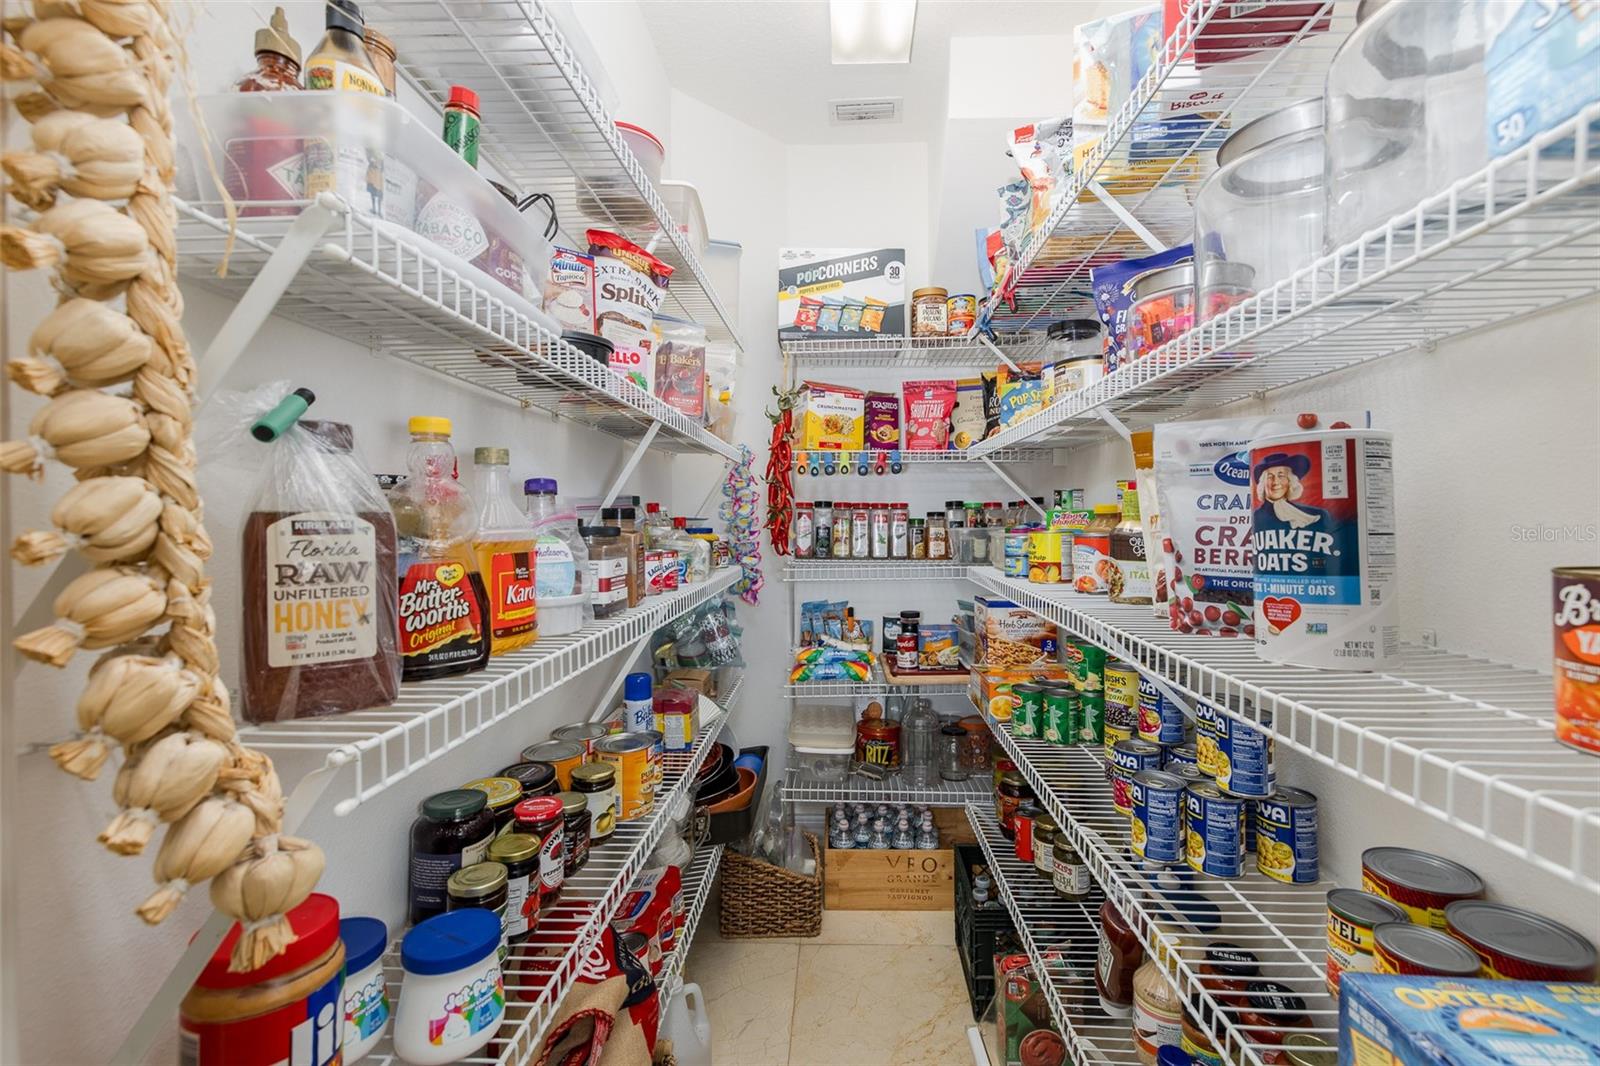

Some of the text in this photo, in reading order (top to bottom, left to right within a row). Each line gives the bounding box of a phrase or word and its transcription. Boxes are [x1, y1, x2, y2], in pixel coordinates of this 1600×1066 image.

[796, 256, 878, 286] POPCORNERS
[889, 266, 900, 276] 30
[601, 282, 654, 312] Splits
[1219, 462, 1250, 480] Ocean
[286, 539, 359, 558] Florida
[1258, 553, 1308, 572] OATS
[275, 561, 370, 586] RAW
[415, 579, 440, 594] Mrs.
[1212, 579, 1229, 588] THE
[1263, 583, 1304, 595] 1-MINUTE
[1308, 585, 1336, 596] OATS
[273, 586, 369, 601] UNFILTERED
[400, 586, 463, 617] Butter-
[506, 584, 535, 605] Karo
[274, 599, 369, 634] HONEY
[405, 599, 470, 632] worth's
[1000, 619, 1016, 629] Herb
[410, 621, 457, 648] Original
[1047, 640, 1052, 648] 3
[866, 745, 889, 765] RITZ
